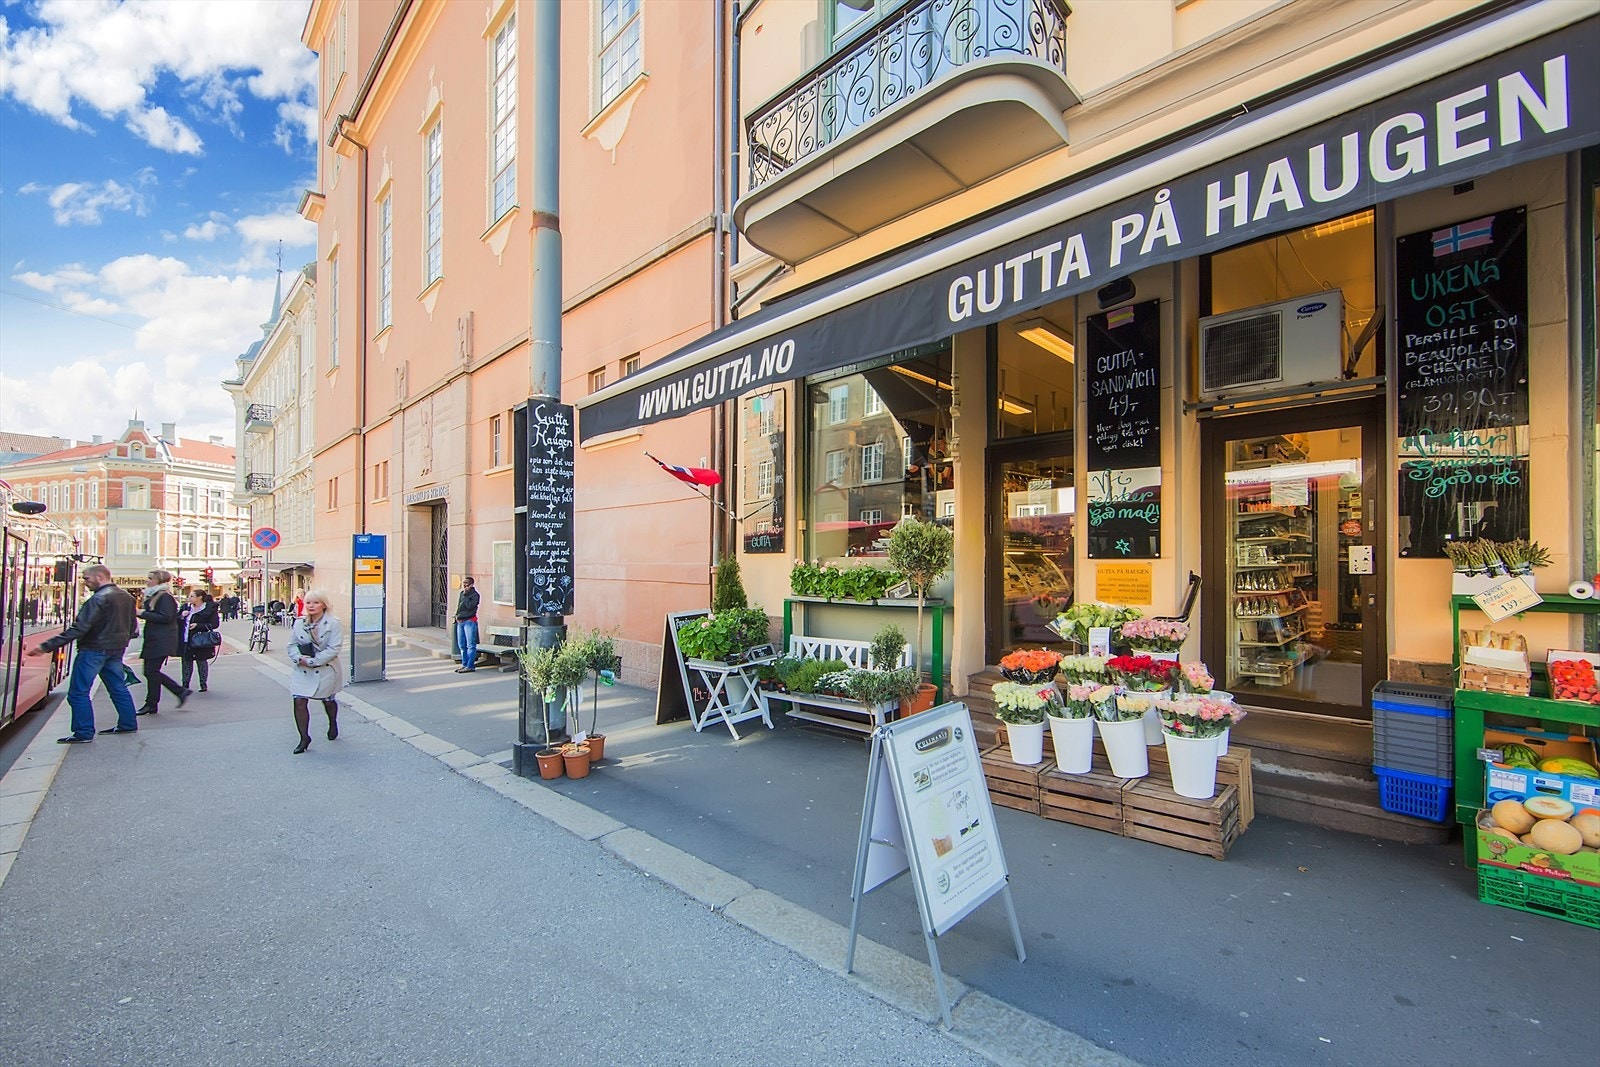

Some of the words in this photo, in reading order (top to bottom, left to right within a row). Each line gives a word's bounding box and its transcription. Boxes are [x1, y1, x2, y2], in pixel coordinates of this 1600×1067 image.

[947, 232, 1092, 322] GUTTA
[1109, 188, 1184, 267] PÅ
[1206, 54, 1571, 235] HAUGEN
[1411, 257, 1500, 301] UKENS
[1300, 304, 1324, 312] Carrier
[1405, 325, 1479, 348] PERSILLE
[1494, 314, 1518, 329] DU
[1097, 349, 1137, 374] GUTTA
[1405, 336, 1516, 366] BEAUJOLAIS
[637, 339, 795, 420] WWW.GUTTA.NO
[1418, 355, 1493, 376] CHEVRE
[1091, 368, 1156, 397] SANDWICH
[535, 403, 569, 430] Gutta
[531, 424, 573, 452] Haugen
[553, 425, 567, 439] på
